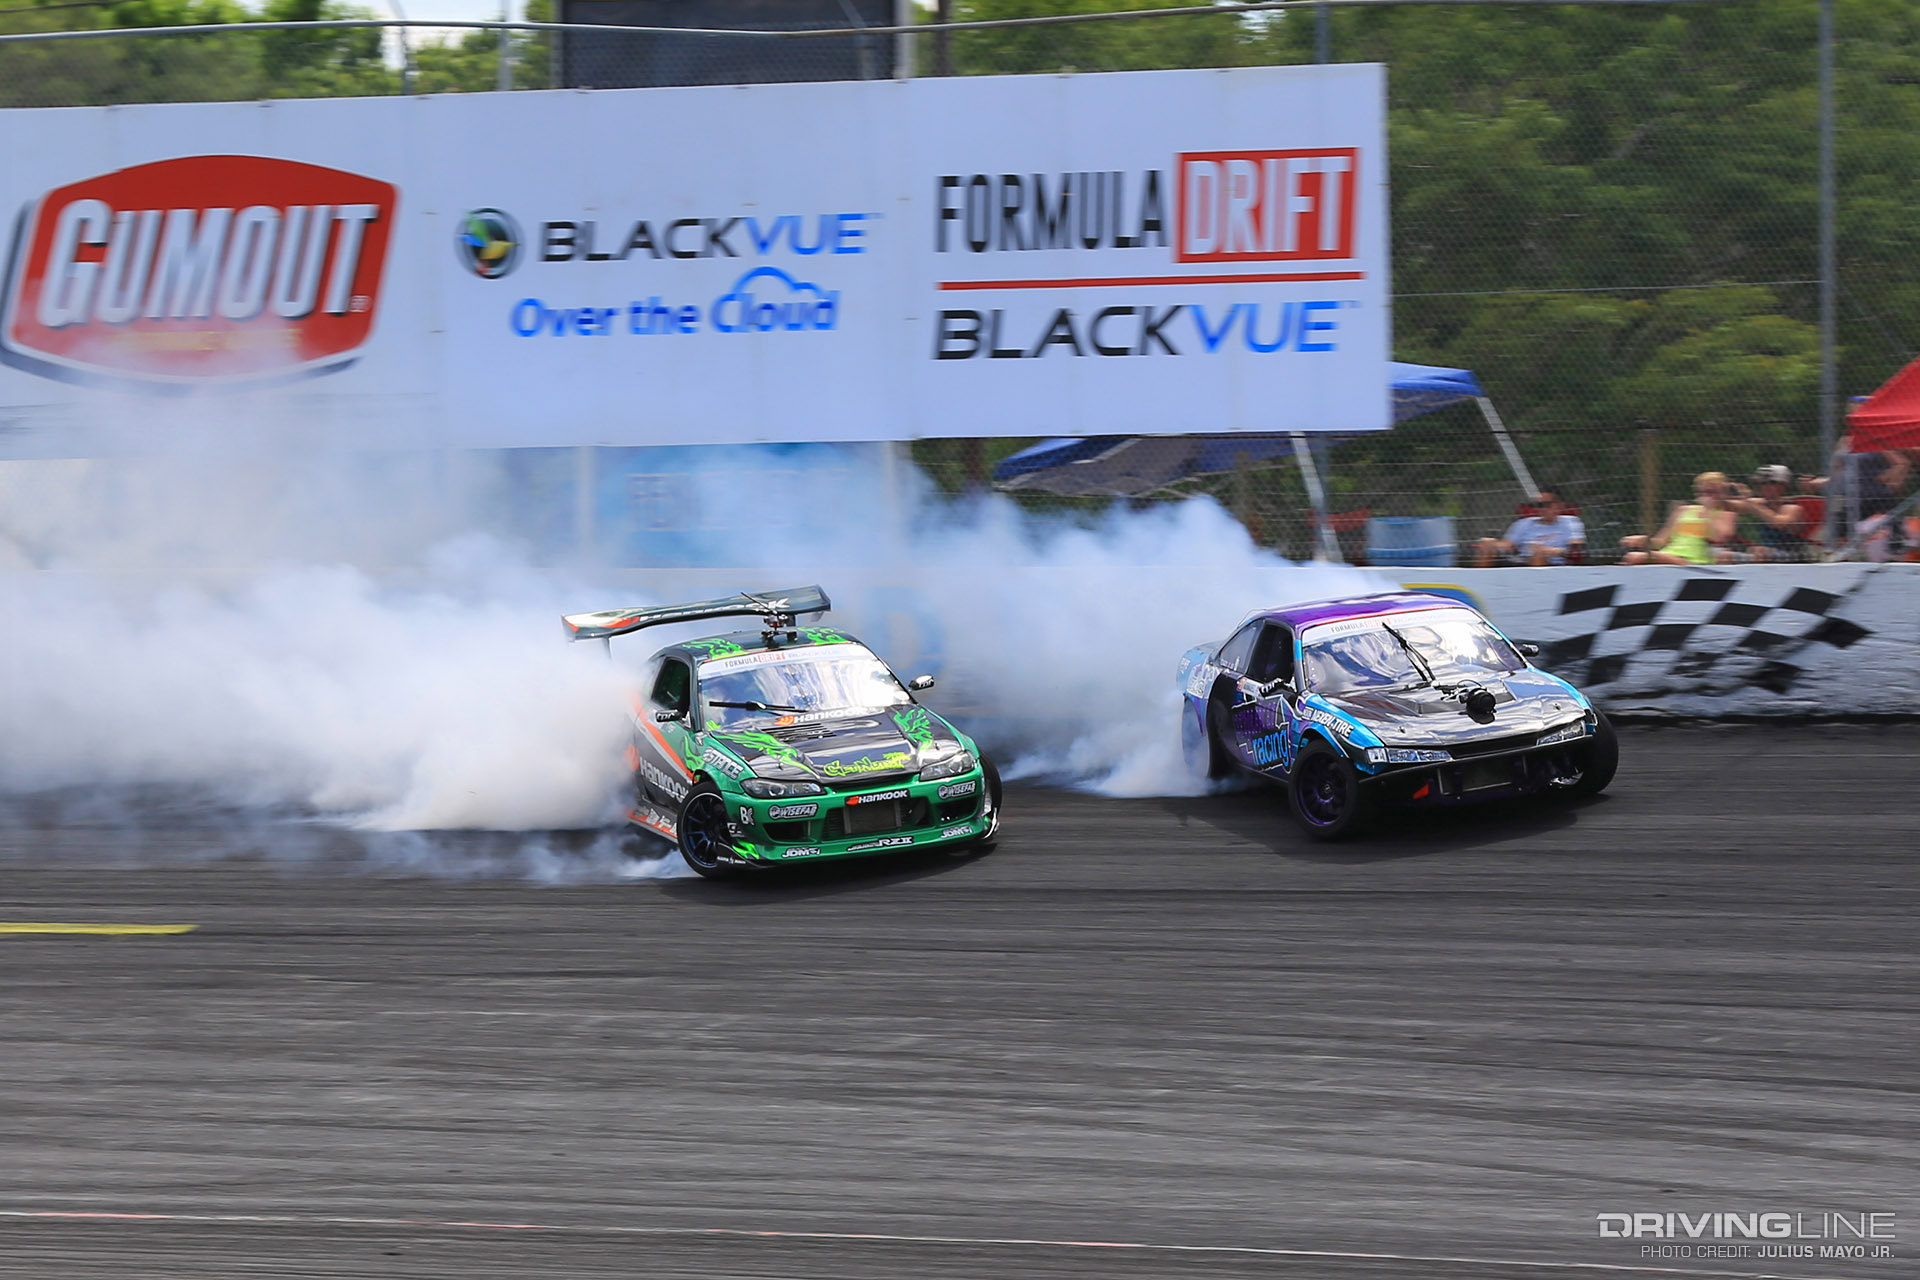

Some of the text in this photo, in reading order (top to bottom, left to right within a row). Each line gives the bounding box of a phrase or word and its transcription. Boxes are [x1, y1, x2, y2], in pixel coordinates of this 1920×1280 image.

[935, 154, 1354, 256] FORMULA DRIFT
[538, 213, 868, 262] BLACKVUE
[37, 198, 379, 328] GUMOUT
[511, 267, 841, 338] Over the Cloud
[932, 300, 1343, 360] BLACKVUE
[724, 656, 758, 669] FORMULA
[1252, 729, 1289, 766] racing
[1332, 718, 1355, 738] TIRE
[702, 747, 744, 780] STANCE
[781, 804, 818, 817] WISEFAB
